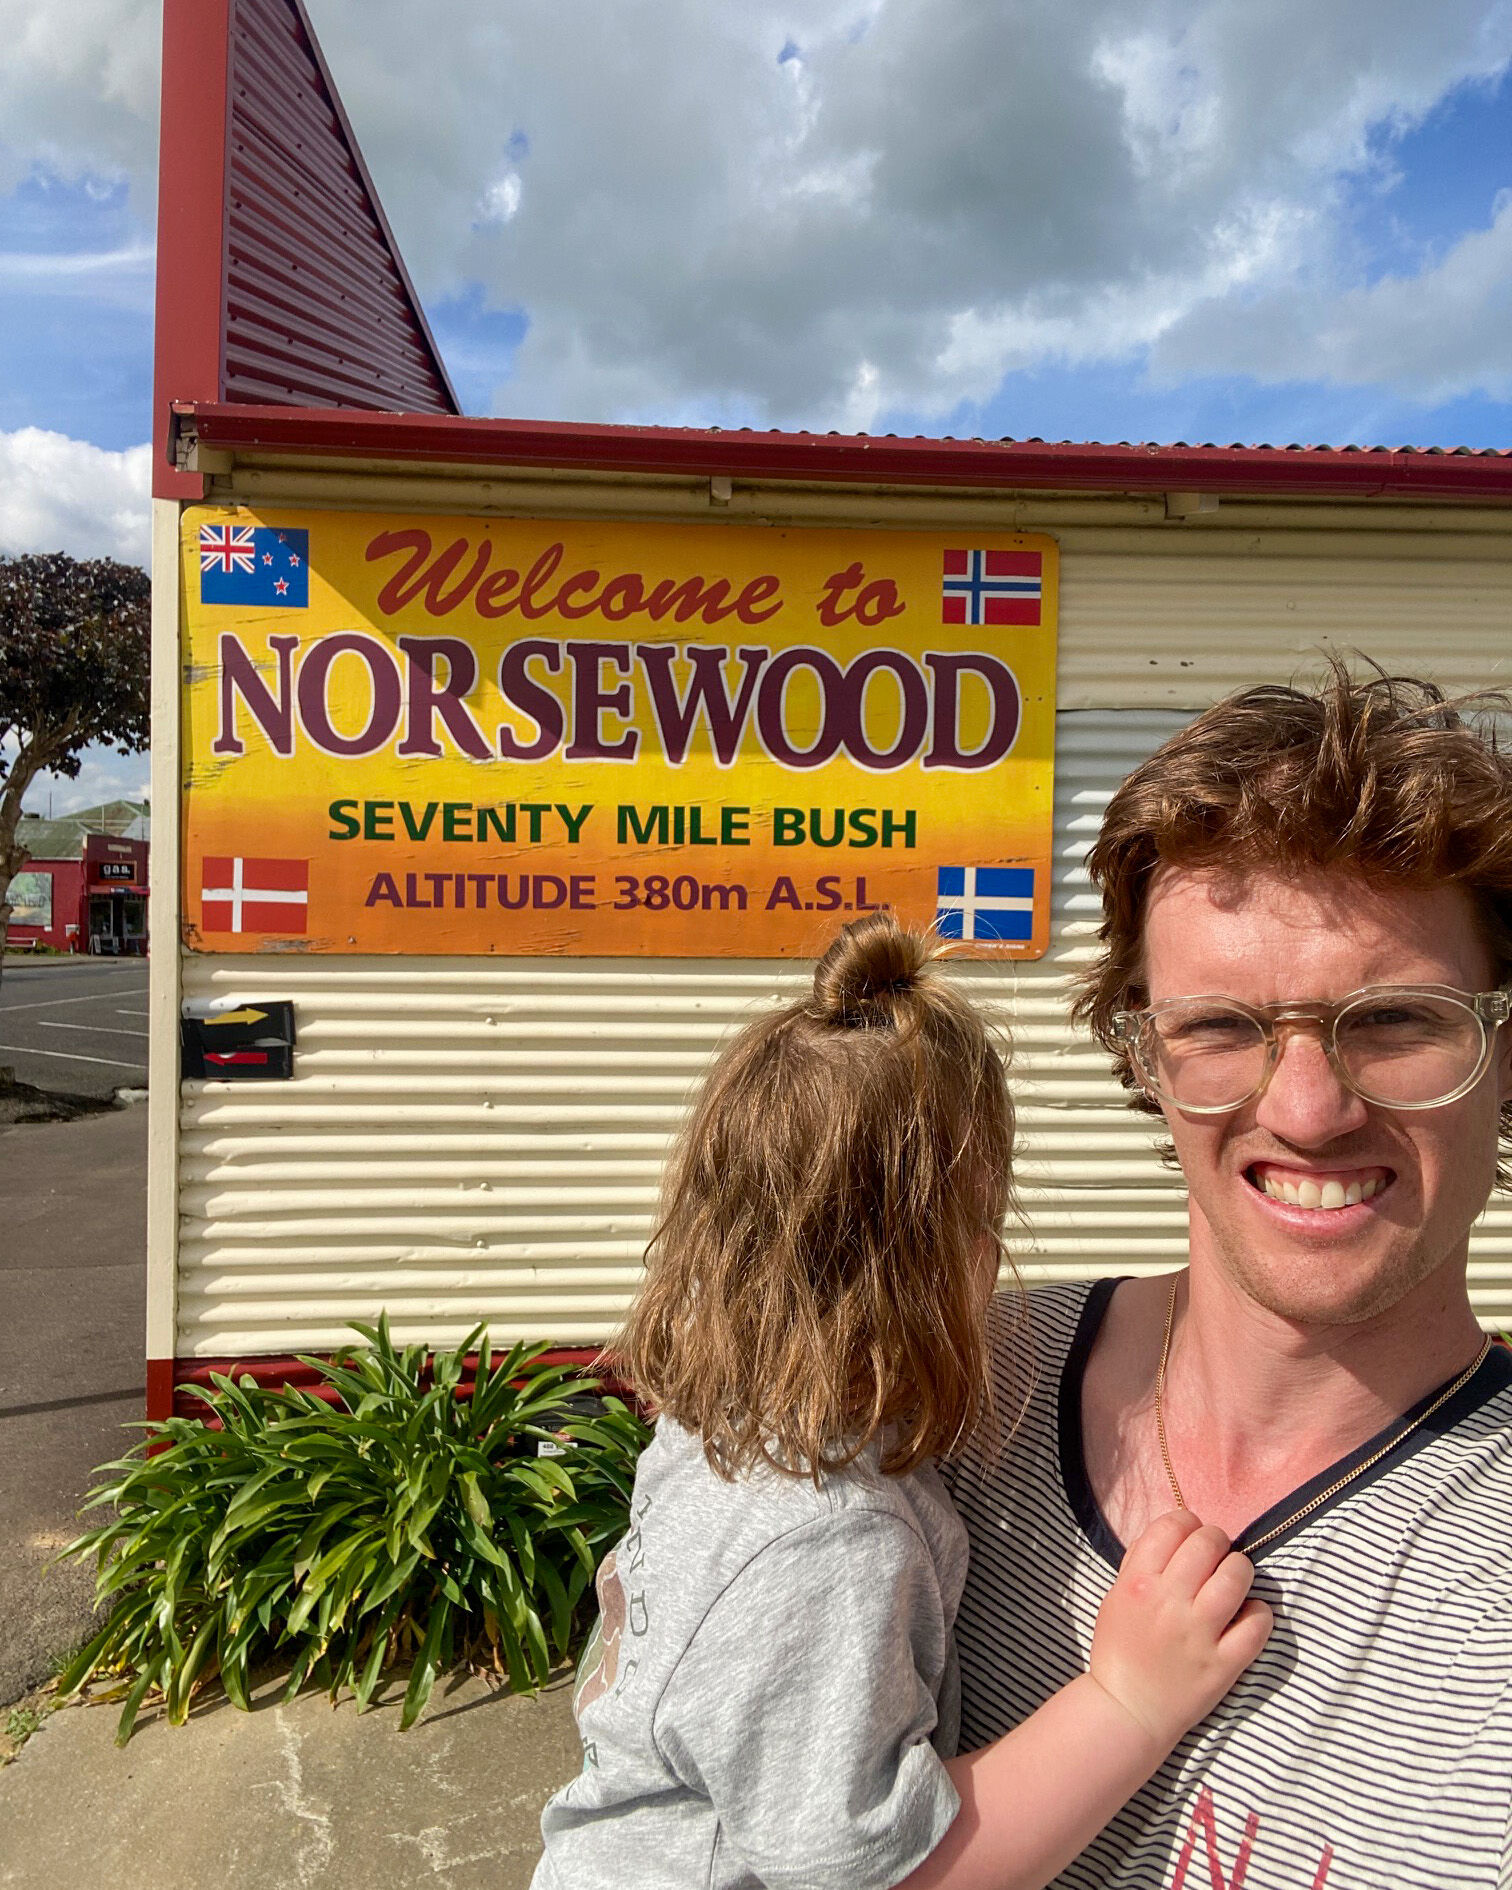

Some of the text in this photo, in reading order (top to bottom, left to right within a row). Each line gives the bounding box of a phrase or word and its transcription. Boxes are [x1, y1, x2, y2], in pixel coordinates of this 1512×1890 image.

[366, 529, 906, 627] Welcome to
[212, 632, 1021, 771] NORSEWOOD
[328, 799, 917, 849] SEVENTY MILE BUSH
[364, 872, 891, 912] ALTITUDE 380m A.S.L.
